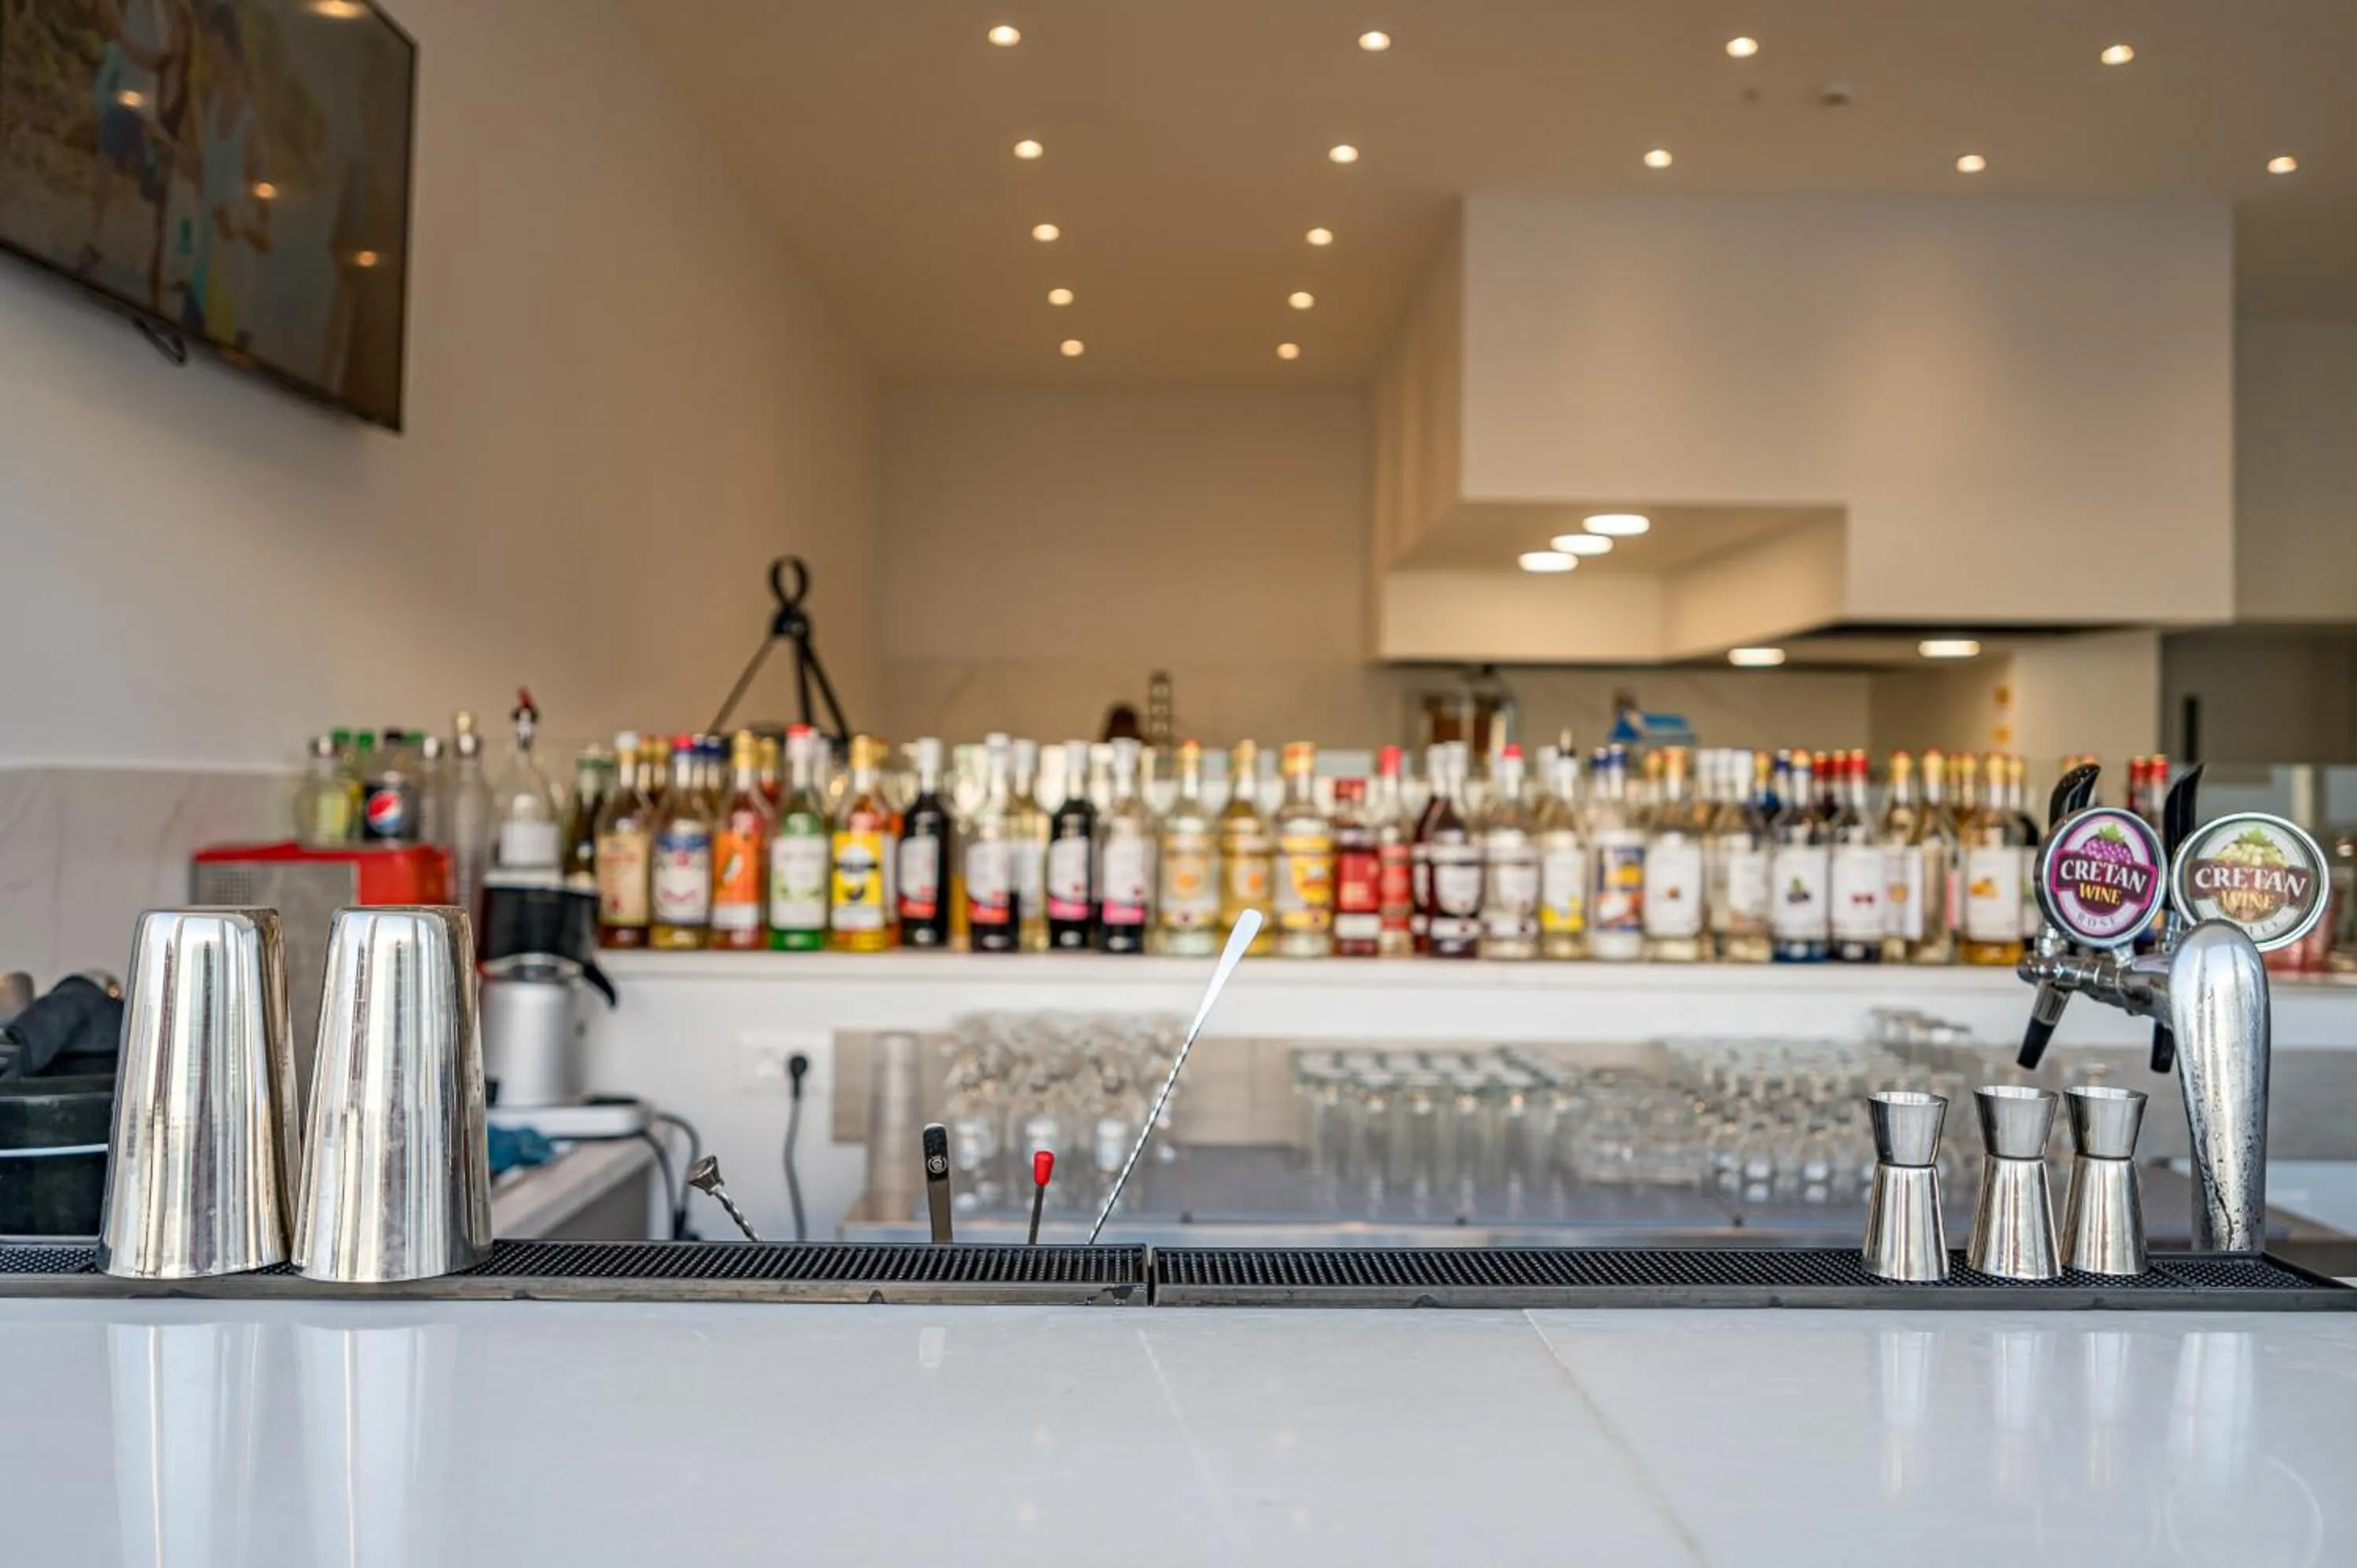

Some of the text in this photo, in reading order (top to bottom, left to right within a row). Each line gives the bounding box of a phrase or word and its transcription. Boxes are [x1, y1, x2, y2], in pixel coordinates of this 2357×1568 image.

[2060, 859, 2147, 893] CRETAN
[2194, 865, 2308, 897] CRETAN
[2080, 883, 2121, 905] WINE
[2221, 889, 2275, 910] WINE
